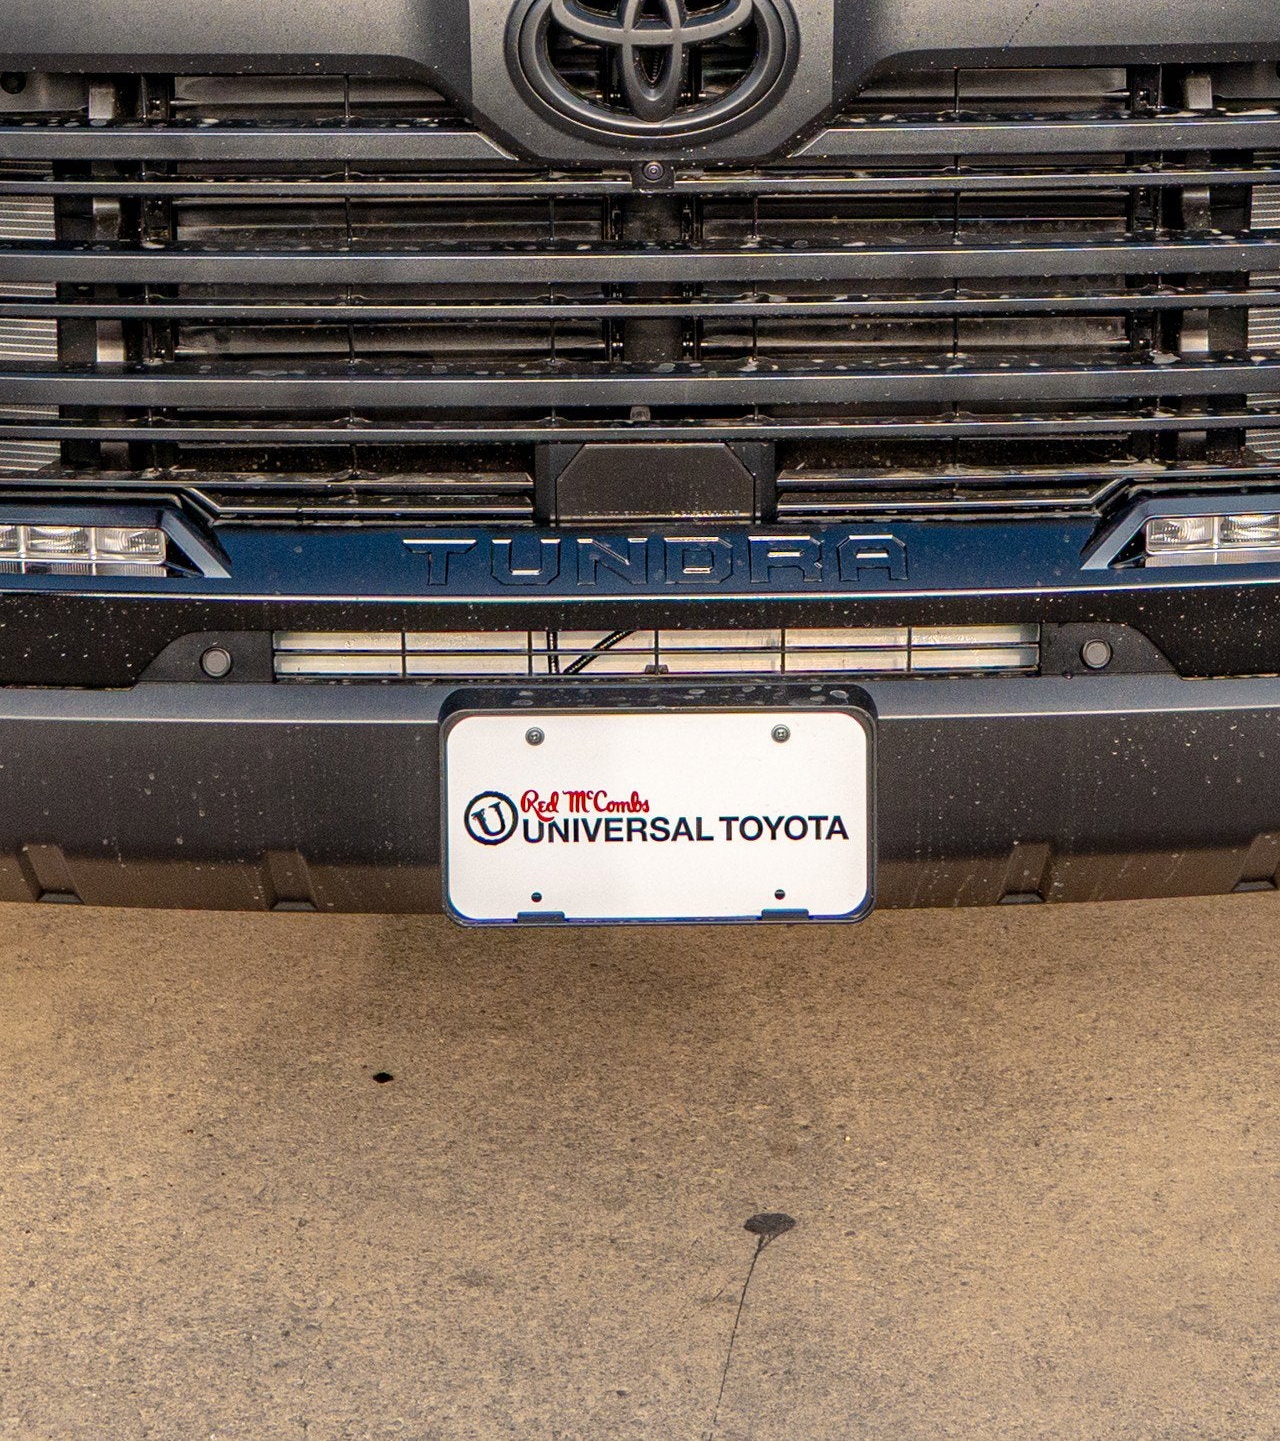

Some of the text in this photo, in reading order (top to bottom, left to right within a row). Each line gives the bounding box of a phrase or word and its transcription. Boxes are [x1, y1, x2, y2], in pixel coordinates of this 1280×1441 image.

[402, 534, 910, 586] TUNDRA
[521, 789, 650, 823] Red McCombs
[523, 815, 850, 843] UNIVERSAL TOYOTA
